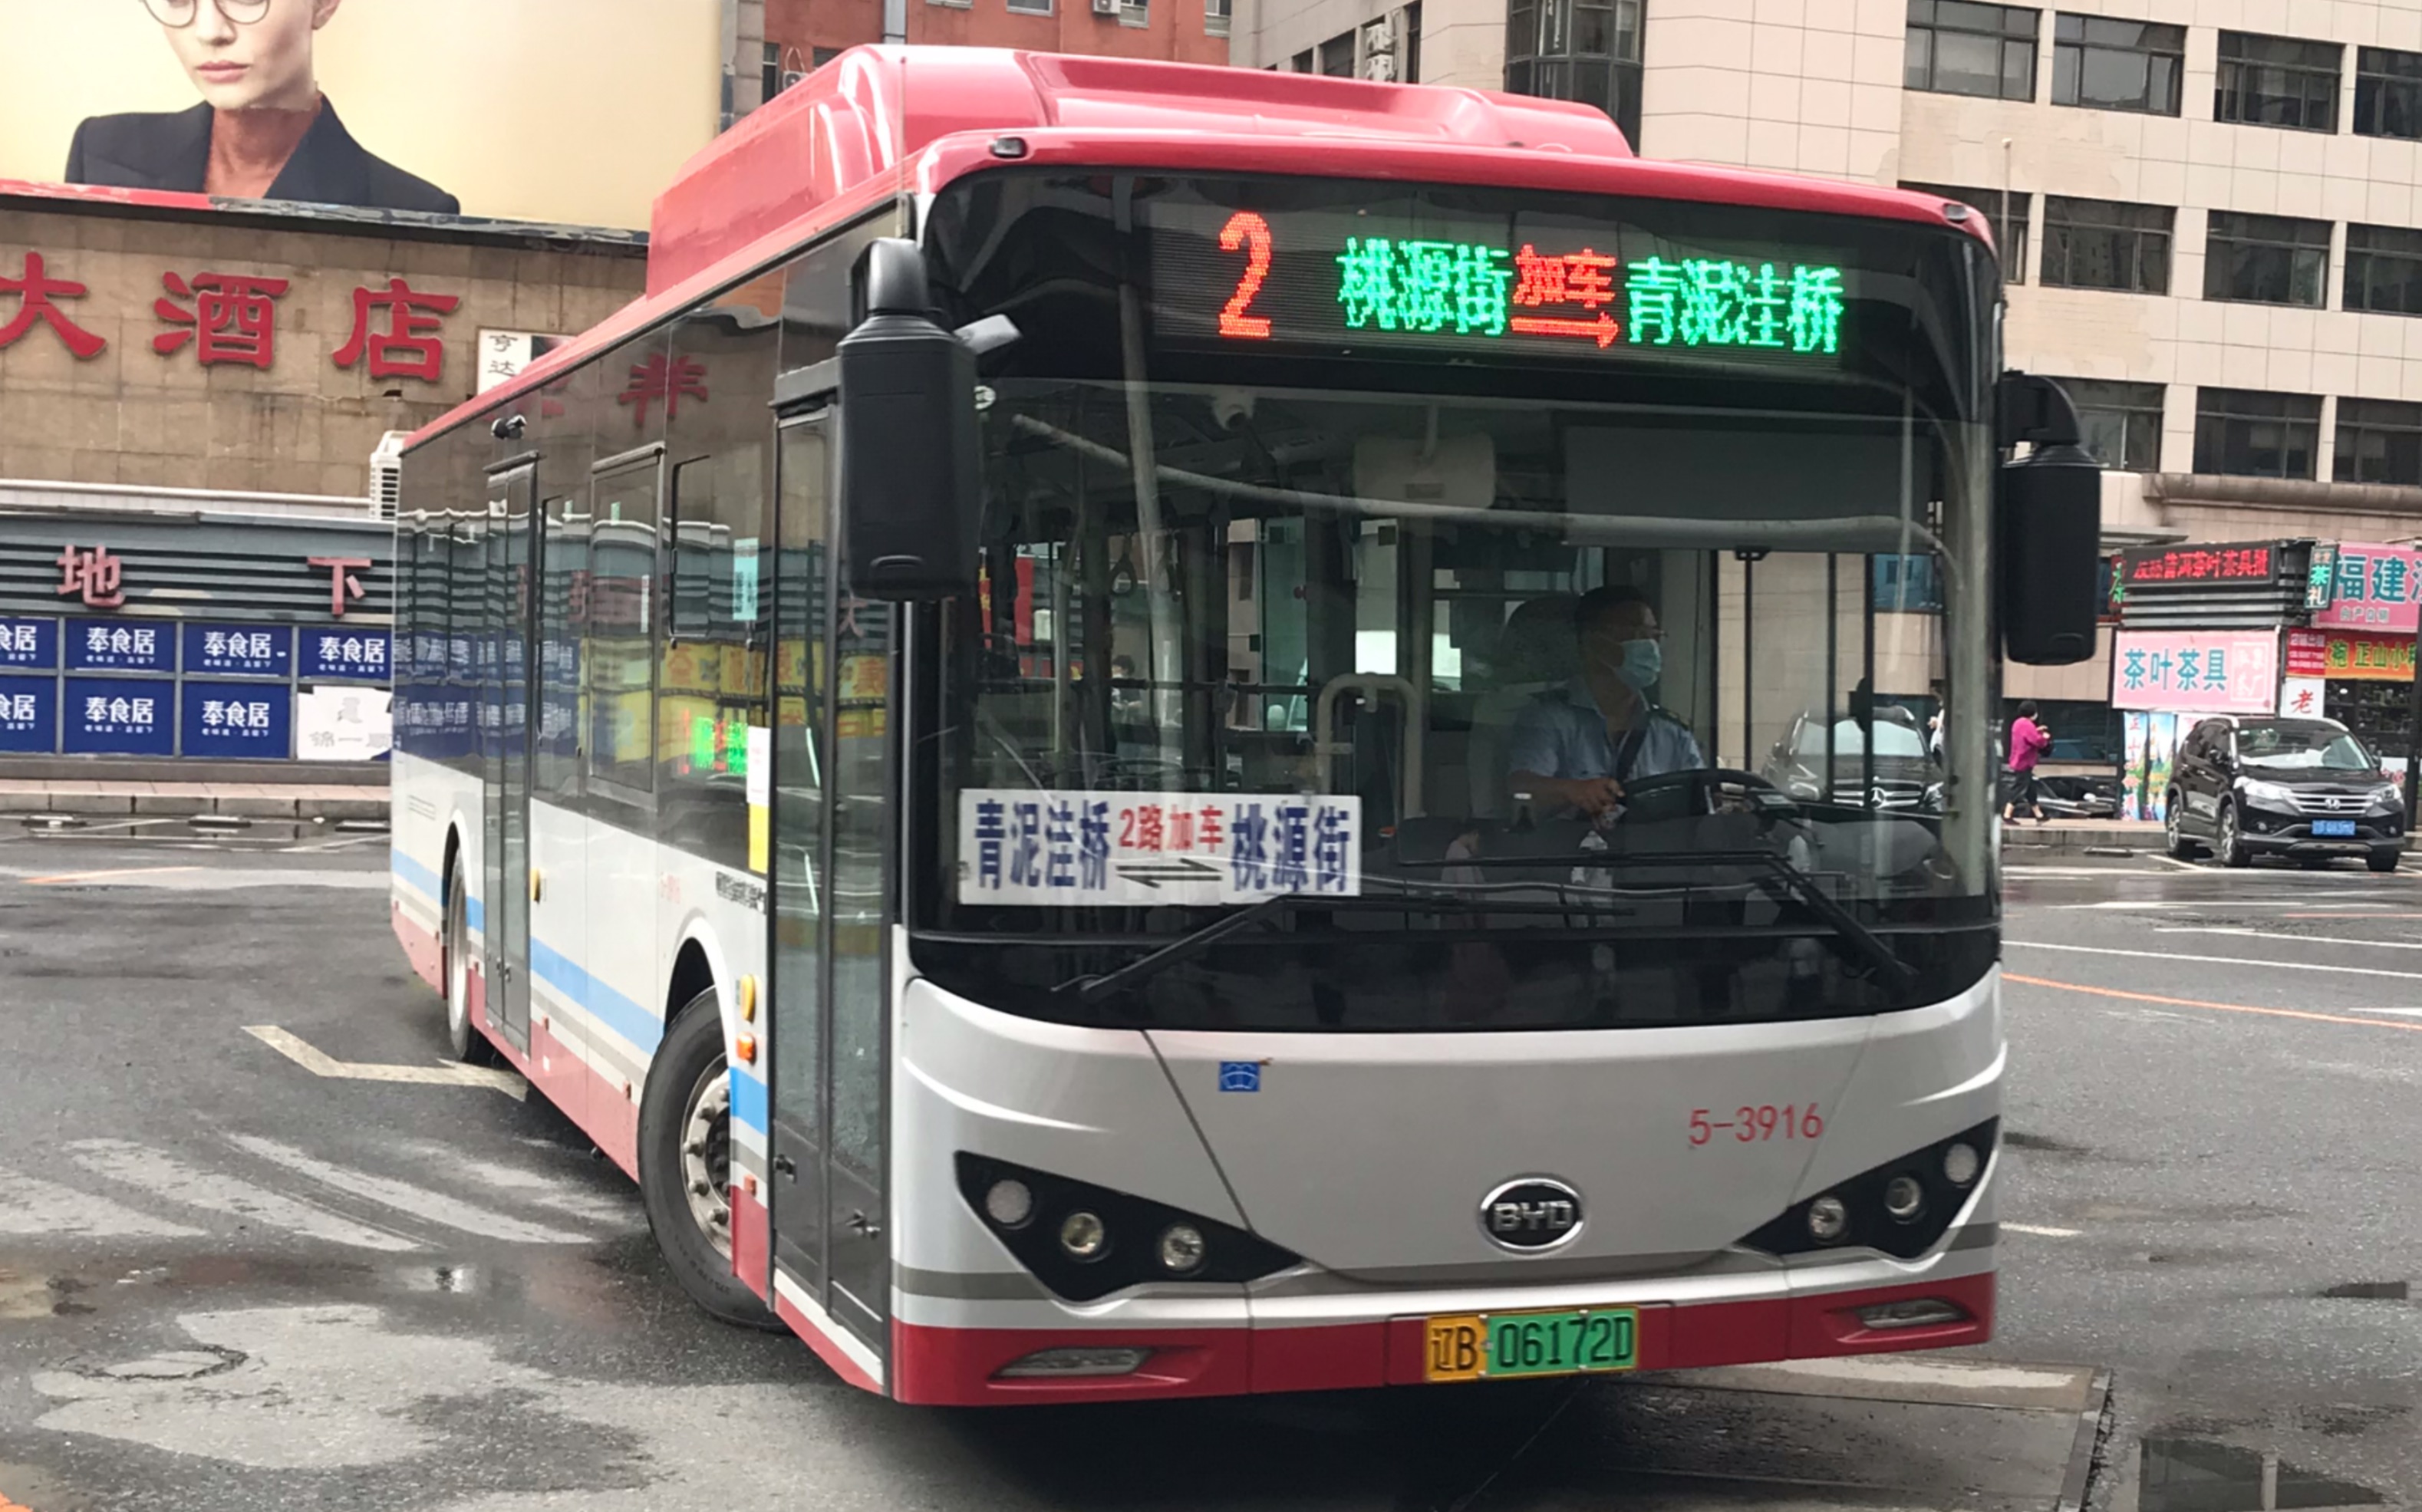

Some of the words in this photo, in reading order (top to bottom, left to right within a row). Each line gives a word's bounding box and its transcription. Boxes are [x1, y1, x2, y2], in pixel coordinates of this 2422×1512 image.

[1218, 211, 1272, 338] 2
[1336, 236, 1512, 334] 桃源街
[1626, 255, 1843, 353] 青泥洼桥
[0, 249, 460, 382] 大酒店
[488, 334, 519, 388] 亨达
[2124, 648, 2227, 691] 茶叶茶具
[2290, 689, 2314, 714] 老
[975, 799, 1110, 891] 青泥洼桥
[1119, 803, 1225, 854] 2路加车
[1231, 802, 1349, 893] 桃源街
[1689, 1102, 1824, 1145] 5-3916
[1493, 1200, 1573, 1231] BYD
